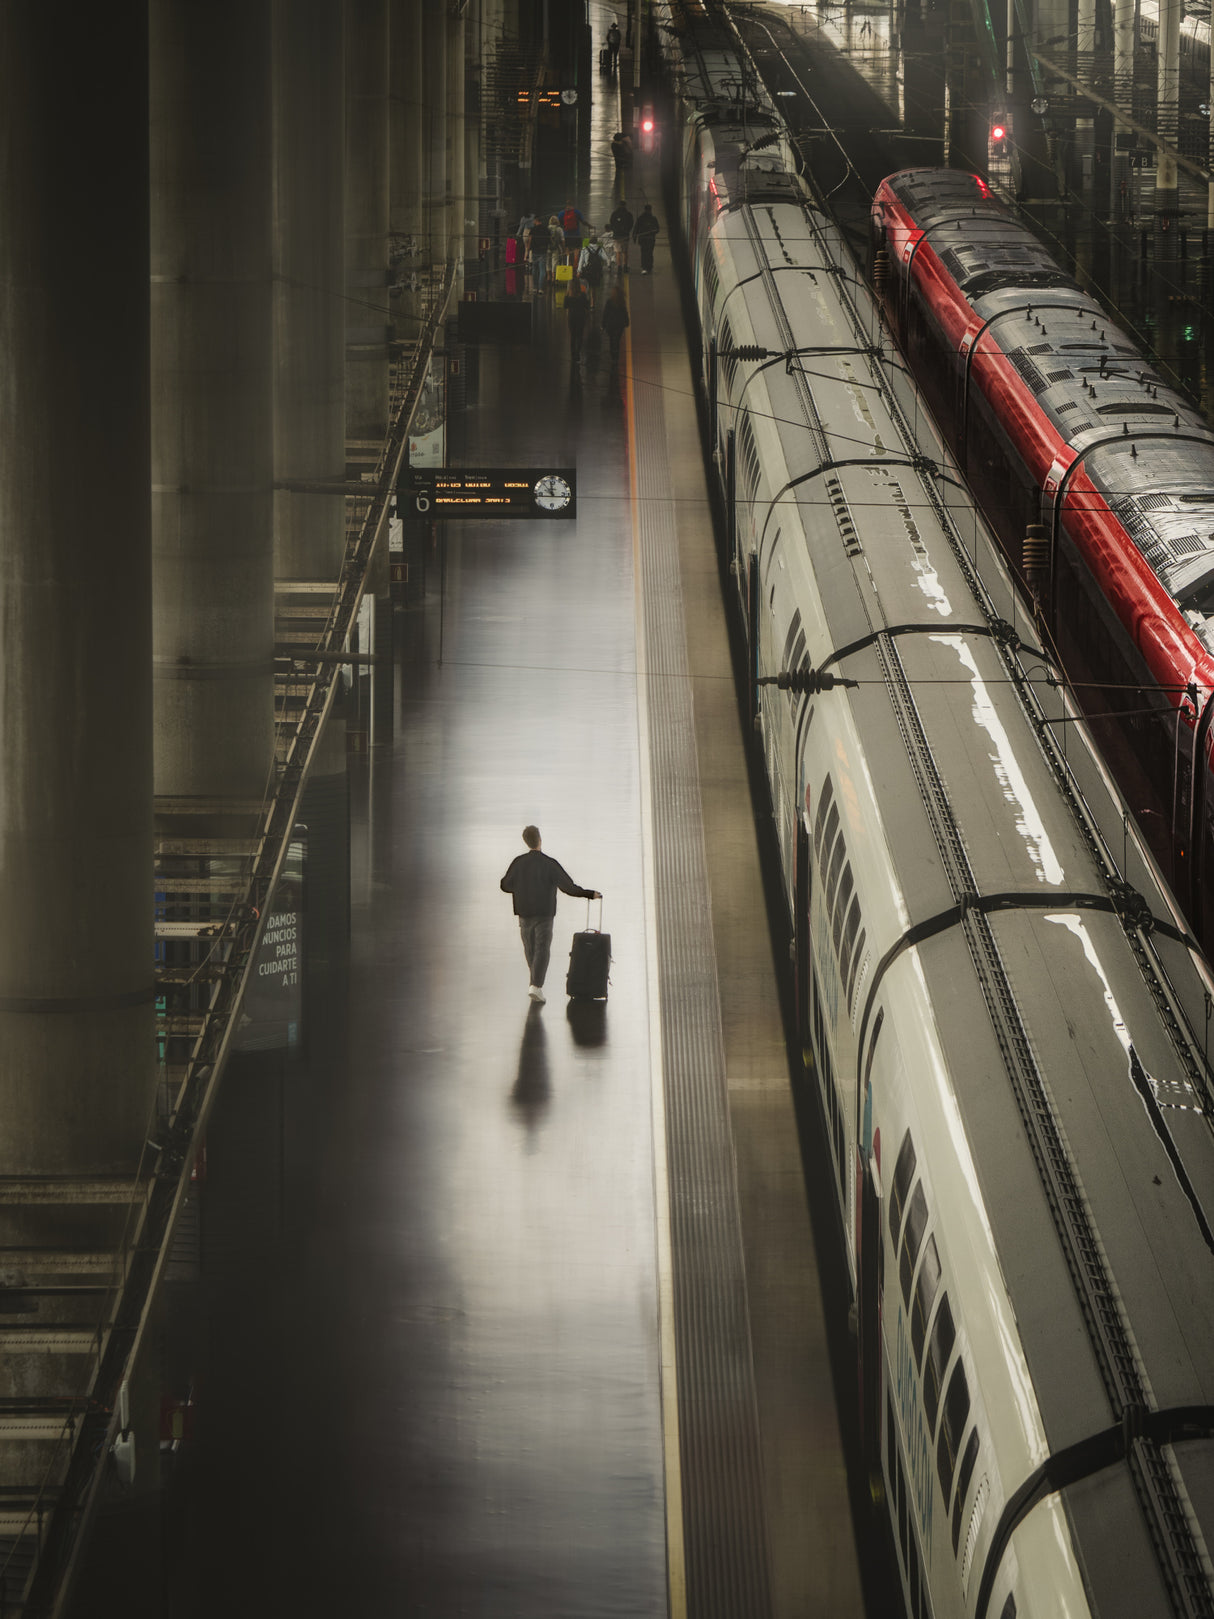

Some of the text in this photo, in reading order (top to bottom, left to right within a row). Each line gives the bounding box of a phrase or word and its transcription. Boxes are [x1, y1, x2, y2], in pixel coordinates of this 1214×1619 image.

[416, 489, 430, 512] 6
[266, 912, 297, 929] IDAMOS
[262, 927, 297, 945] NUNCIOS
[276, 942, 297, 957] PARA
[258, 957, 297, 976] CUIDARTE
[282, 973, 297, 986] A TI
